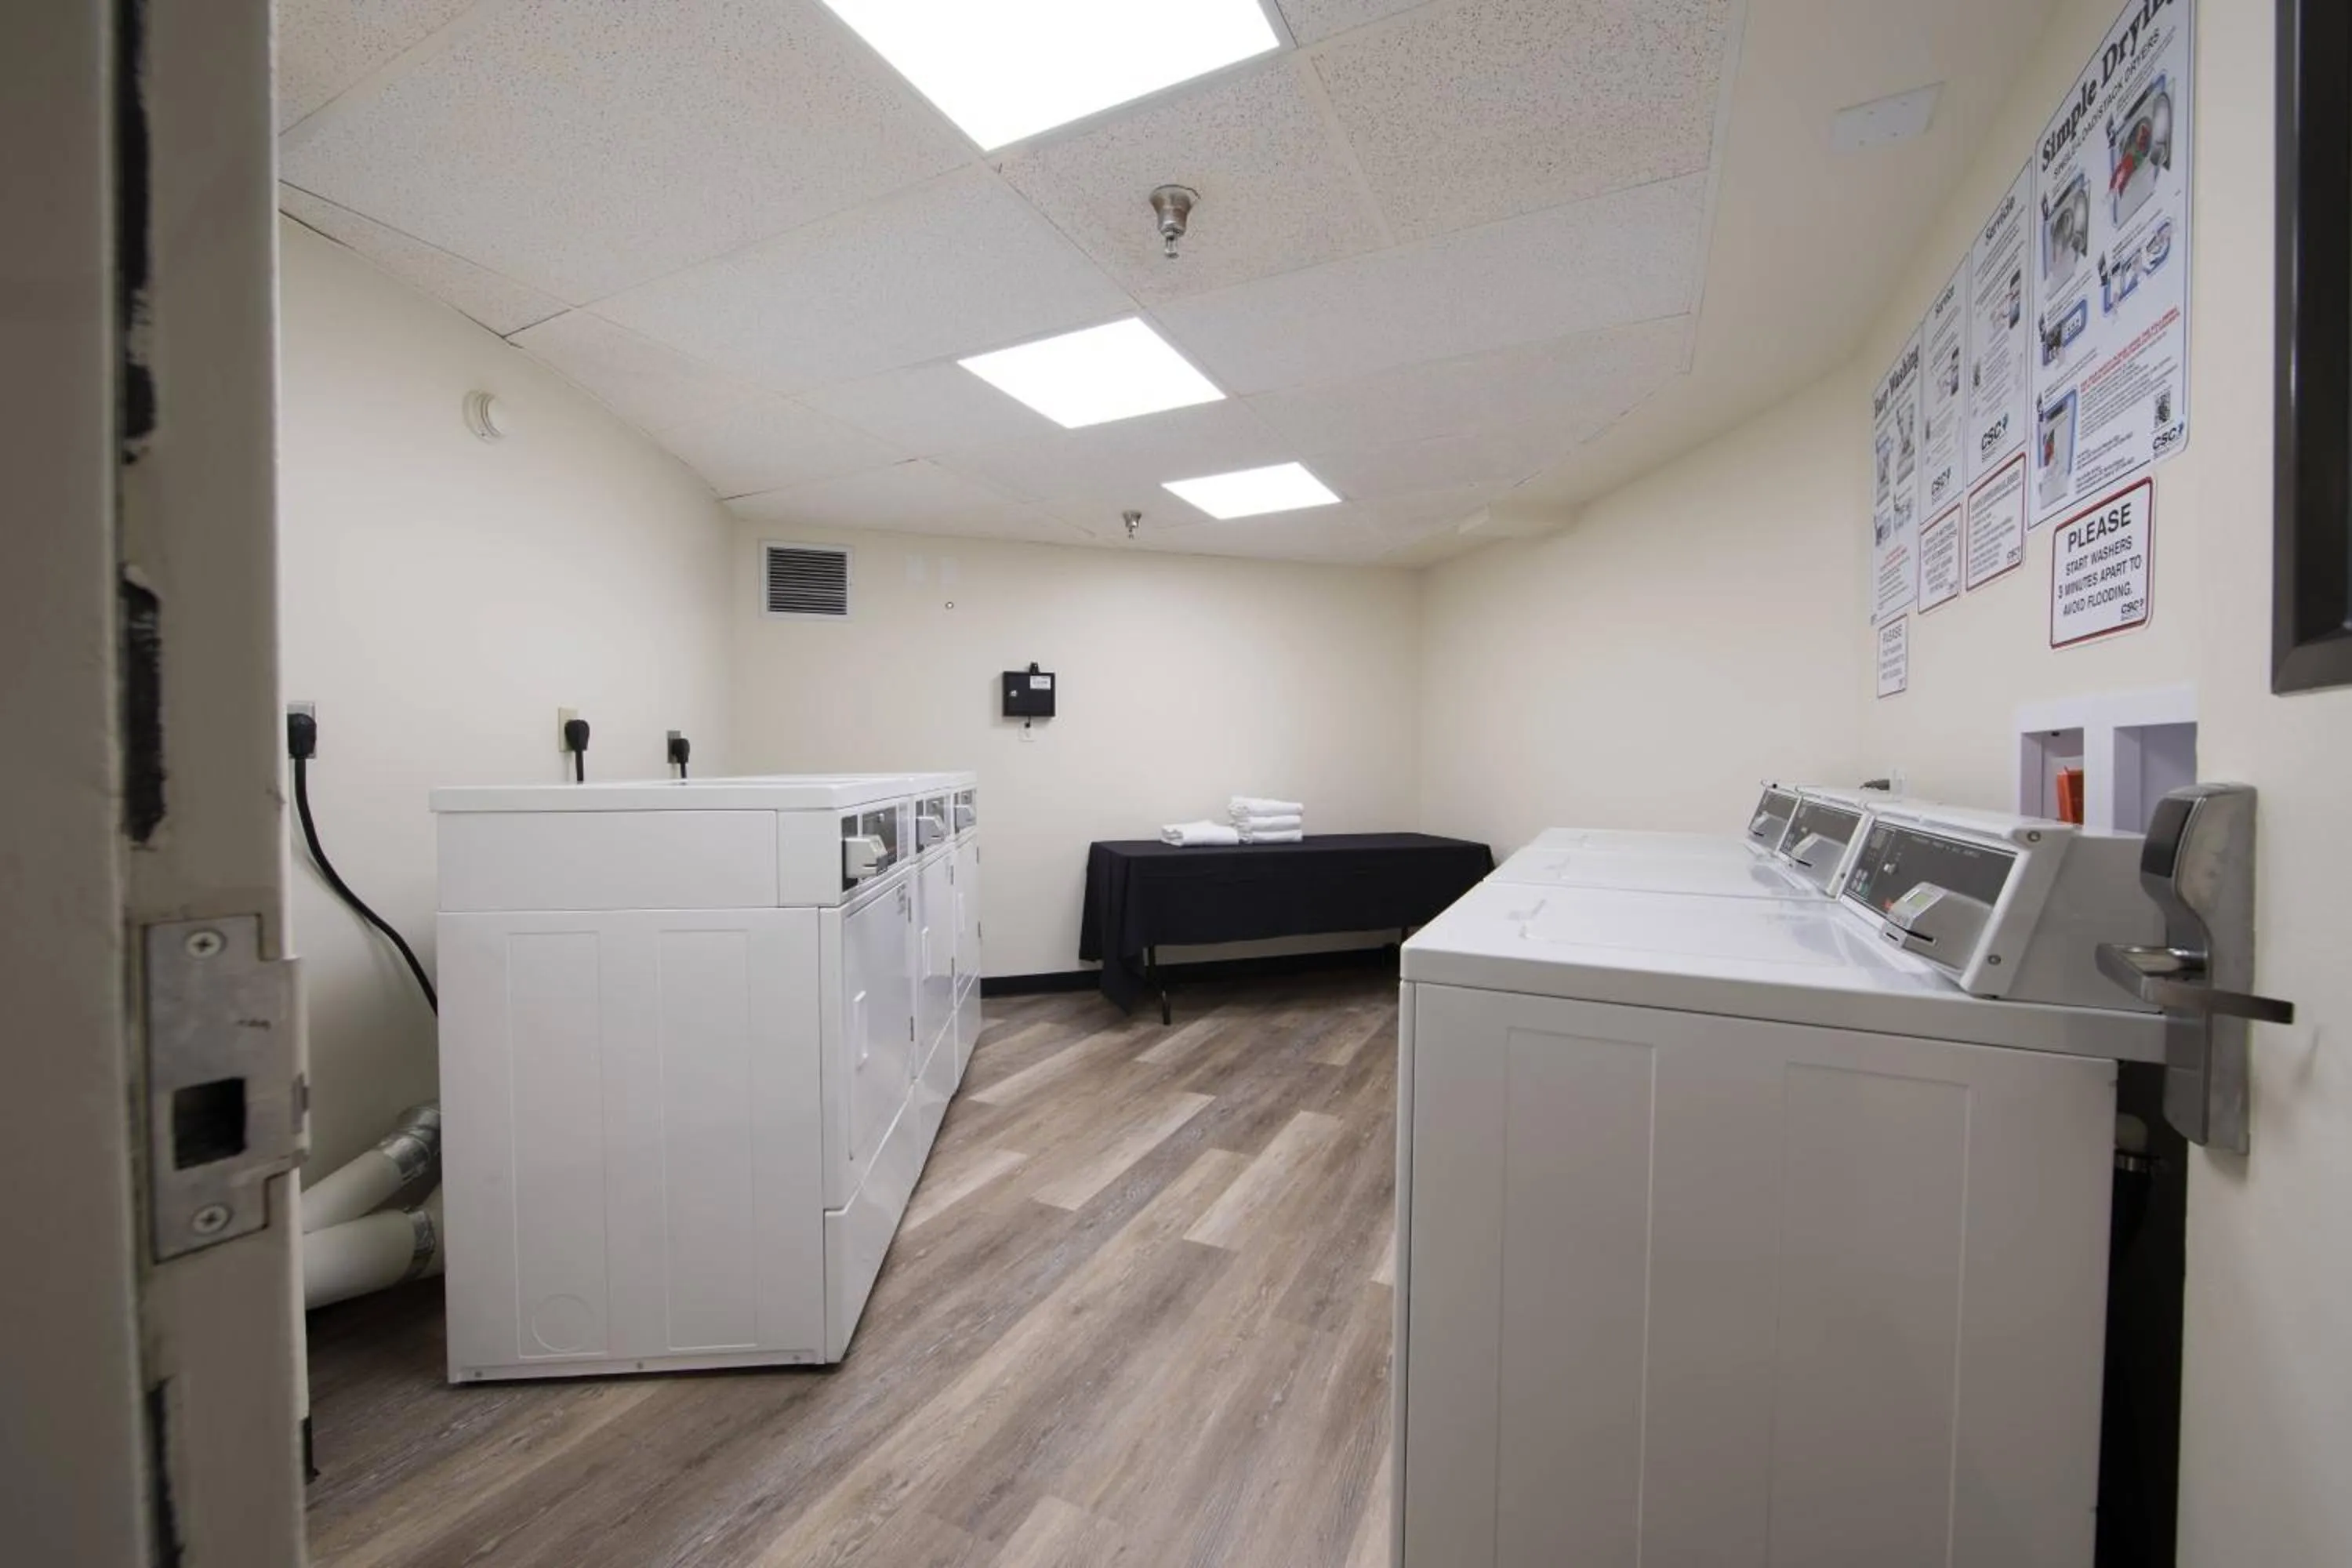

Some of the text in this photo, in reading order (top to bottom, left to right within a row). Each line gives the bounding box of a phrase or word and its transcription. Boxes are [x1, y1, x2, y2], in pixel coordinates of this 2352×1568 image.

[2042, 79, 2096, 172] Simple
[2101, 0, 2173, 88] Dryi
[2067, 503, 2132, 553] PLEASE
[2064, 572, 2099, 596] MINUTES
[2100, 561, 2127, 583] APART
[2129, 554, 2142, 572] TO
[2066, 535, 2132, 576] START WASHERS
[2063, 599, 2085, 616] AVOID
